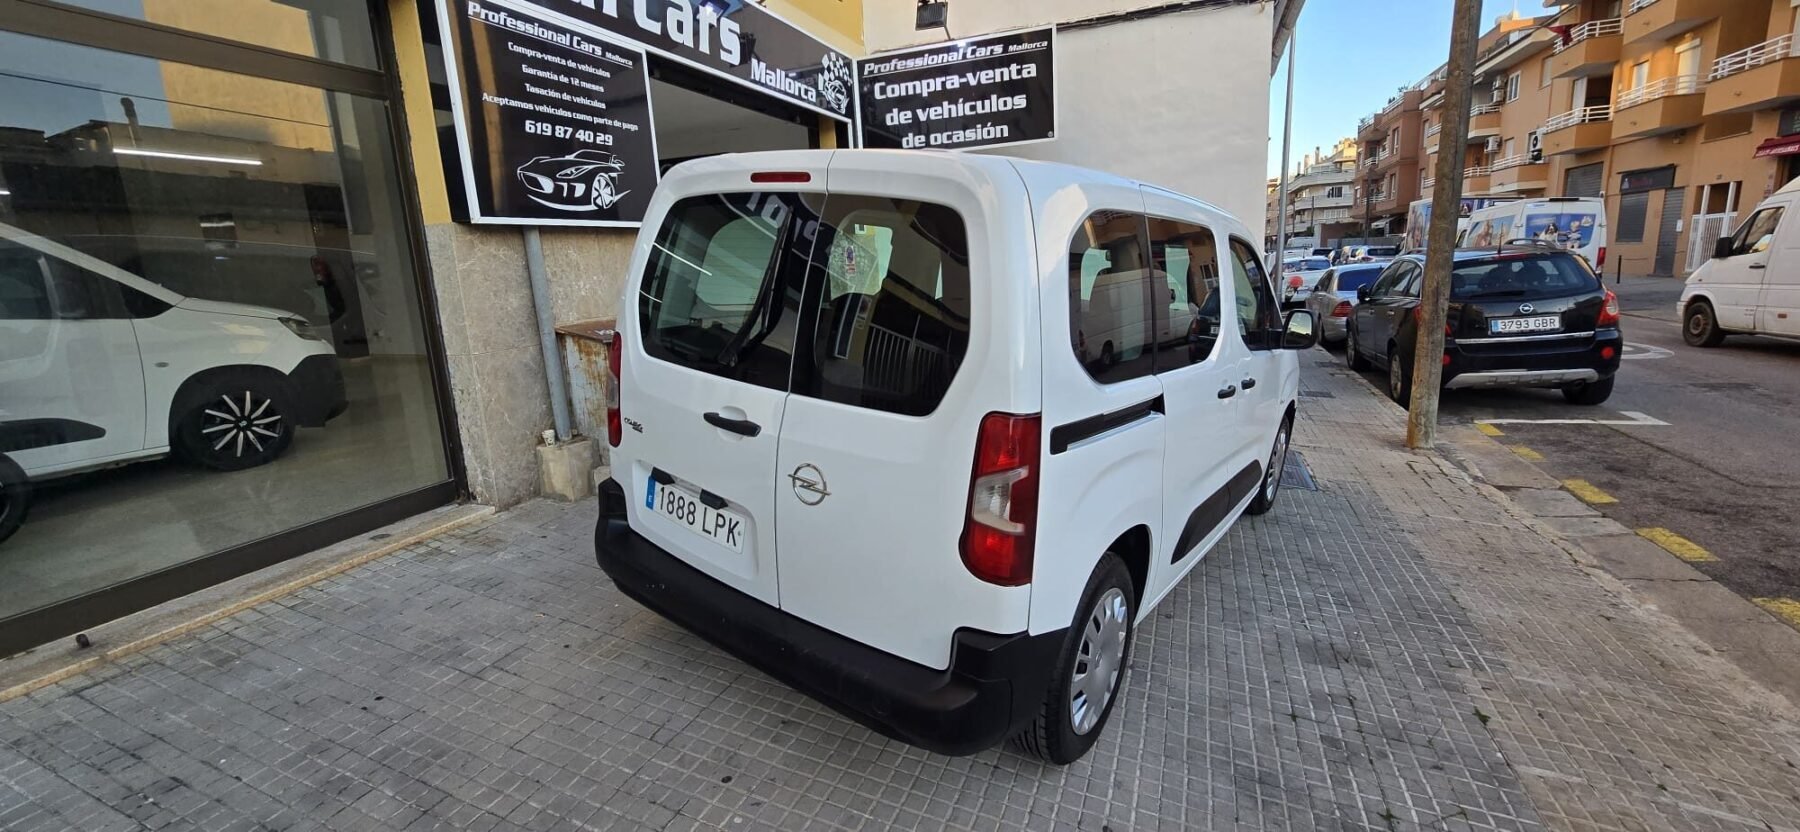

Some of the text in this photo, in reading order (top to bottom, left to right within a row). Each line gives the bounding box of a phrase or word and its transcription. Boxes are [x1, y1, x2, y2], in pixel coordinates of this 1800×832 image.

[467, 1, 570, 46] Professional
[572, 37, 602, 56] Cars
[605, 51, 633, 66] Mallorca
[508, 41, 567, 66] Compra-venta
[567, 58, 577, 69] de
[863, 40, 1048, 76] Professional Cars Mallorca
[524, 83, 561, 100] Tasación
[561, 92, 572, 102] de
[559, 74, 570, 84] de
[570, 76, 580, 87] 12
[580, 80, 604, 93] meses
[751, 57, 816, 103] Mallorca
[873, 62, 1037, 100] Compra-venta
[482, 92, 534, 111] Aceptamos
[572, 112, 593, 123] como
[593, 114, 613, 126] parte
[613, 118, 622, 128] de
[622, 122, 639, 131] pago
[885, 93, 1027, 126] de vehículos
[524, 119, 613, 146] 619 87 40 29
[902, 122, 1009, 149] de ocasión
[1501, 318, 1556, 330] 3793 GBR
[660, 486, 740, 547] 1888 LPK
